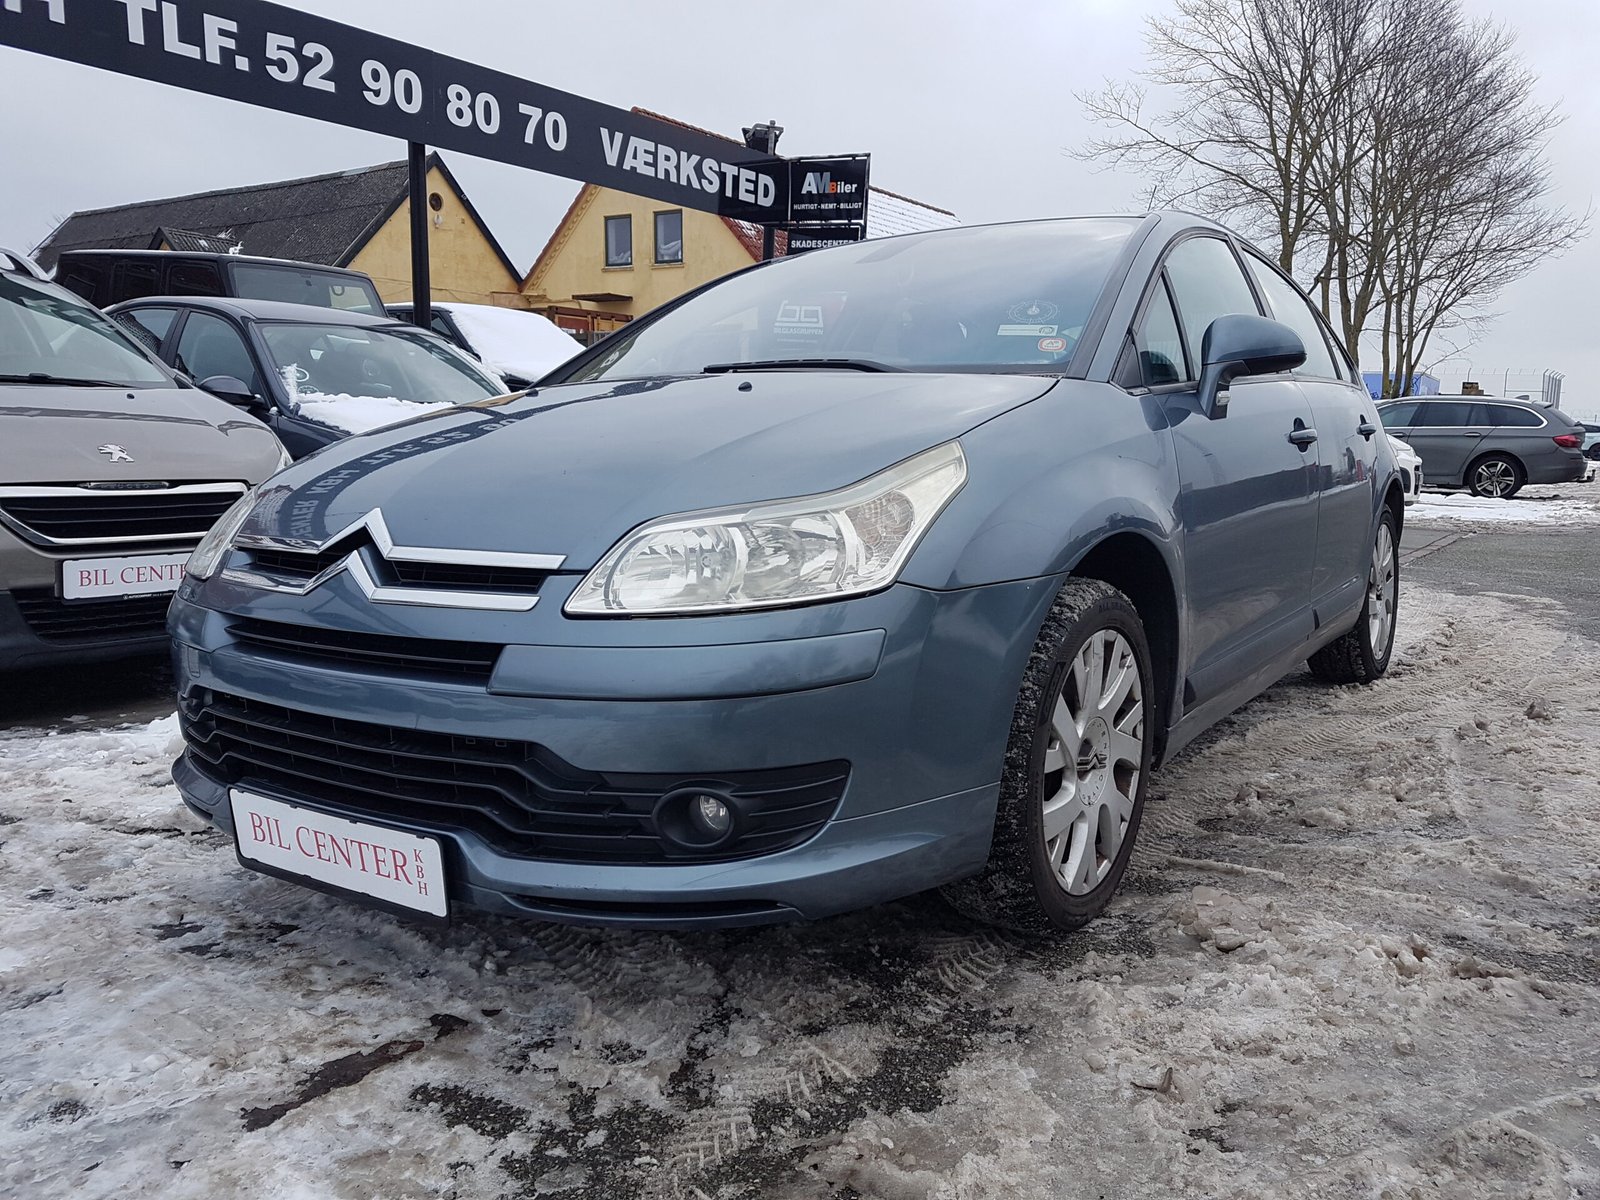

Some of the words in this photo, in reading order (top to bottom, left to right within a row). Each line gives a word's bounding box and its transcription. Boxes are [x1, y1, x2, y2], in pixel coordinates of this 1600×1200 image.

[112, 0, 249, 72] TLF.
[265, 32, 336, 92] 52
[361, 60, 423, 114] 90
[446, 84, 501, 134] 80
[518, 104, 567, 151] 70
[600, 126, 775, 208] VÆRKSTED
[79, 568, 114, 587] BIL
[248, 811, 291, 851] BIL
[295, 826, 413, 886] CENTER
